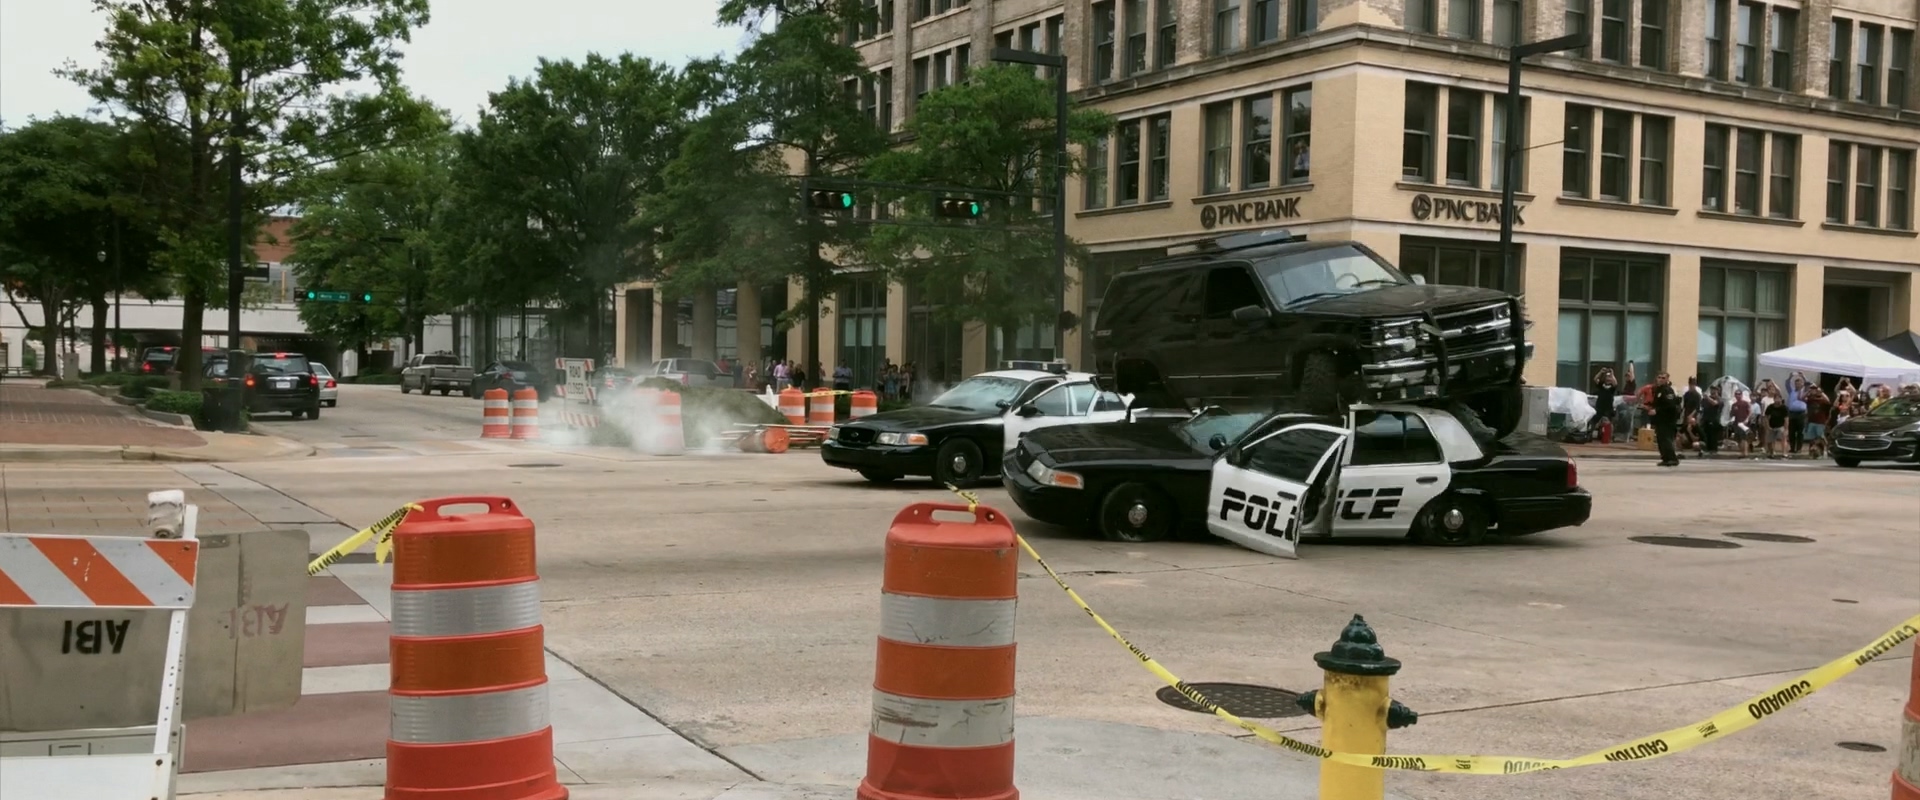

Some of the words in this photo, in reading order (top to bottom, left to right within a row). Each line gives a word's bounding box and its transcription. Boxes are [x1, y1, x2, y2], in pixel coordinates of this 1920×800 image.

[1217, 202, 1253, 225] PNC
[1254, 197, 1301, 221] BANK
[1433, 197, 1474, 221] PNC
[1475, 201, 1525, 226] BAK
[569, 365, 581, 378] ROAD
[567, 382, 584, 395] CLOSED
[61, 619, 131, 654] ABI
[1747, 680, 1811, 720] CUIDADO
[1604, 739, 1669, 762] CAUTION
